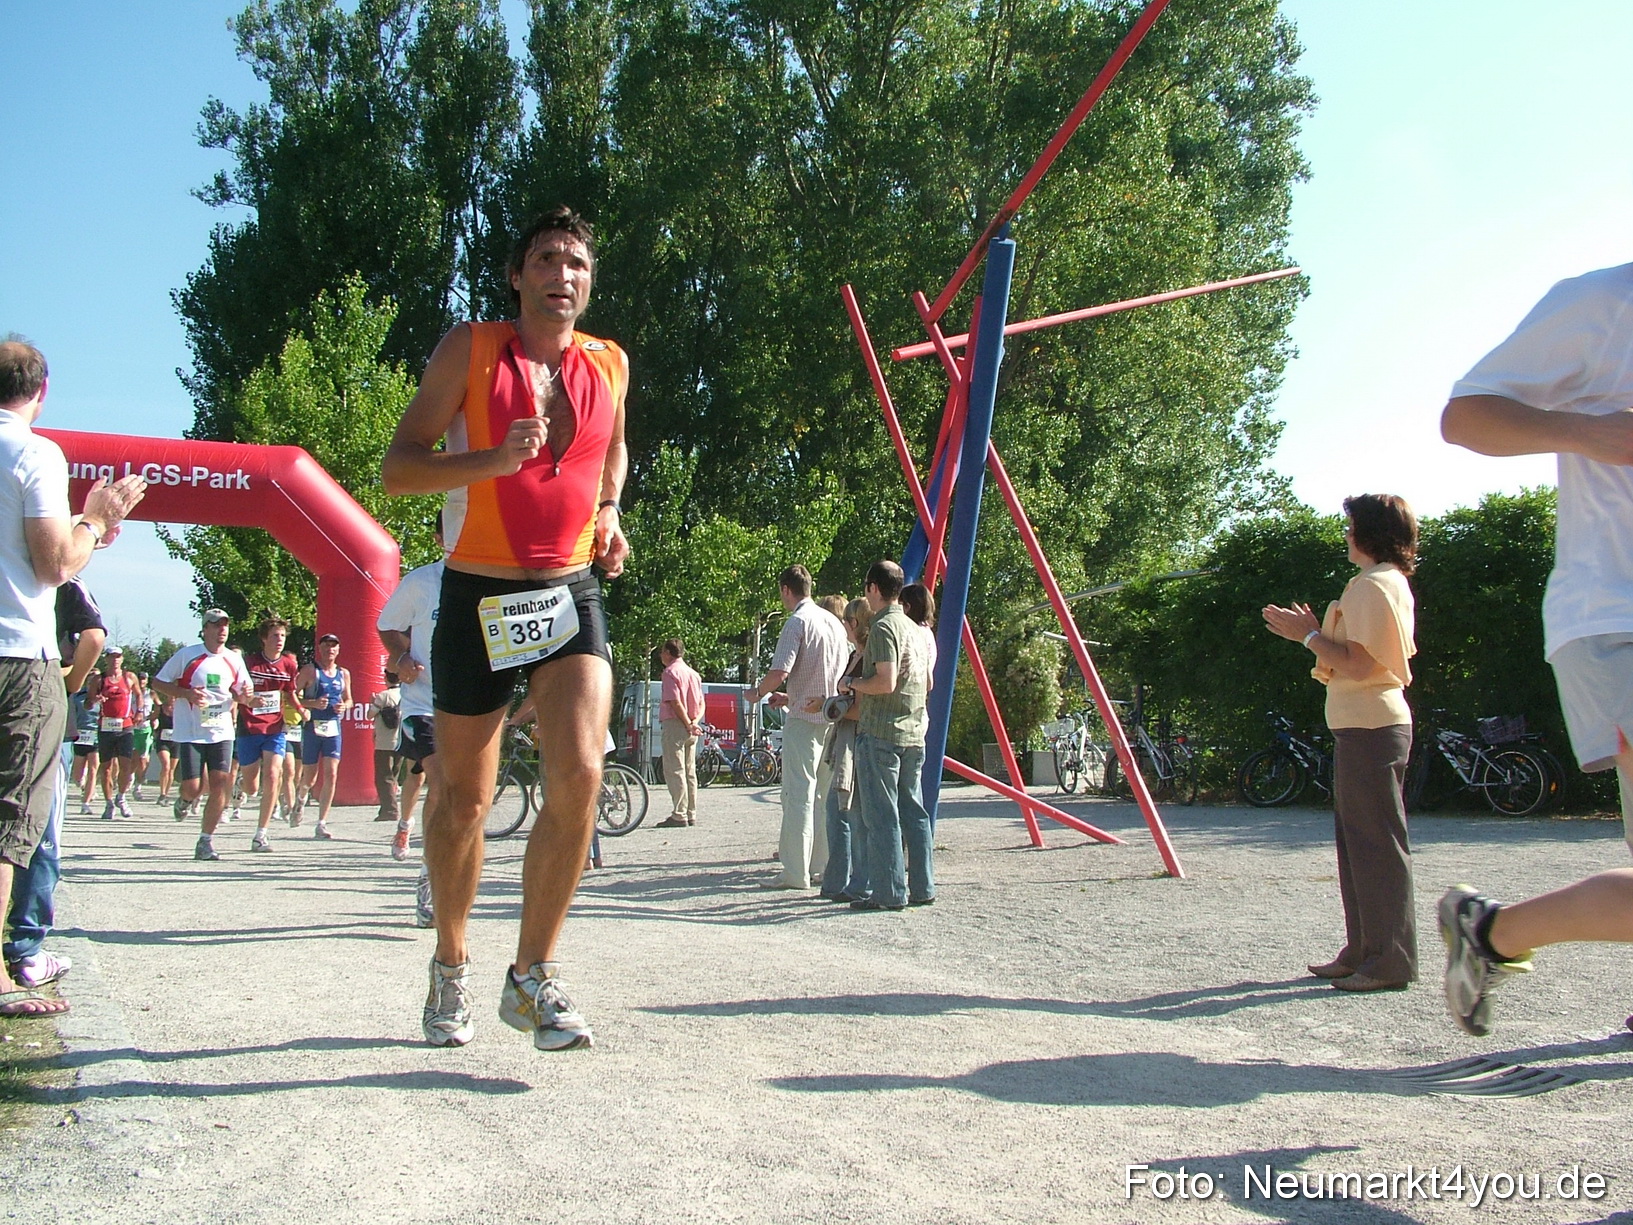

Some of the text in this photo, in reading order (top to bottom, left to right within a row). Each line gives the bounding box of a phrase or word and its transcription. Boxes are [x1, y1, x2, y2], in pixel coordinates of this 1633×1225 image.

[502, 596, 559, 616] reinhard
[488, 624, 499, 637] B
[510, 617, 554, 645] 387
